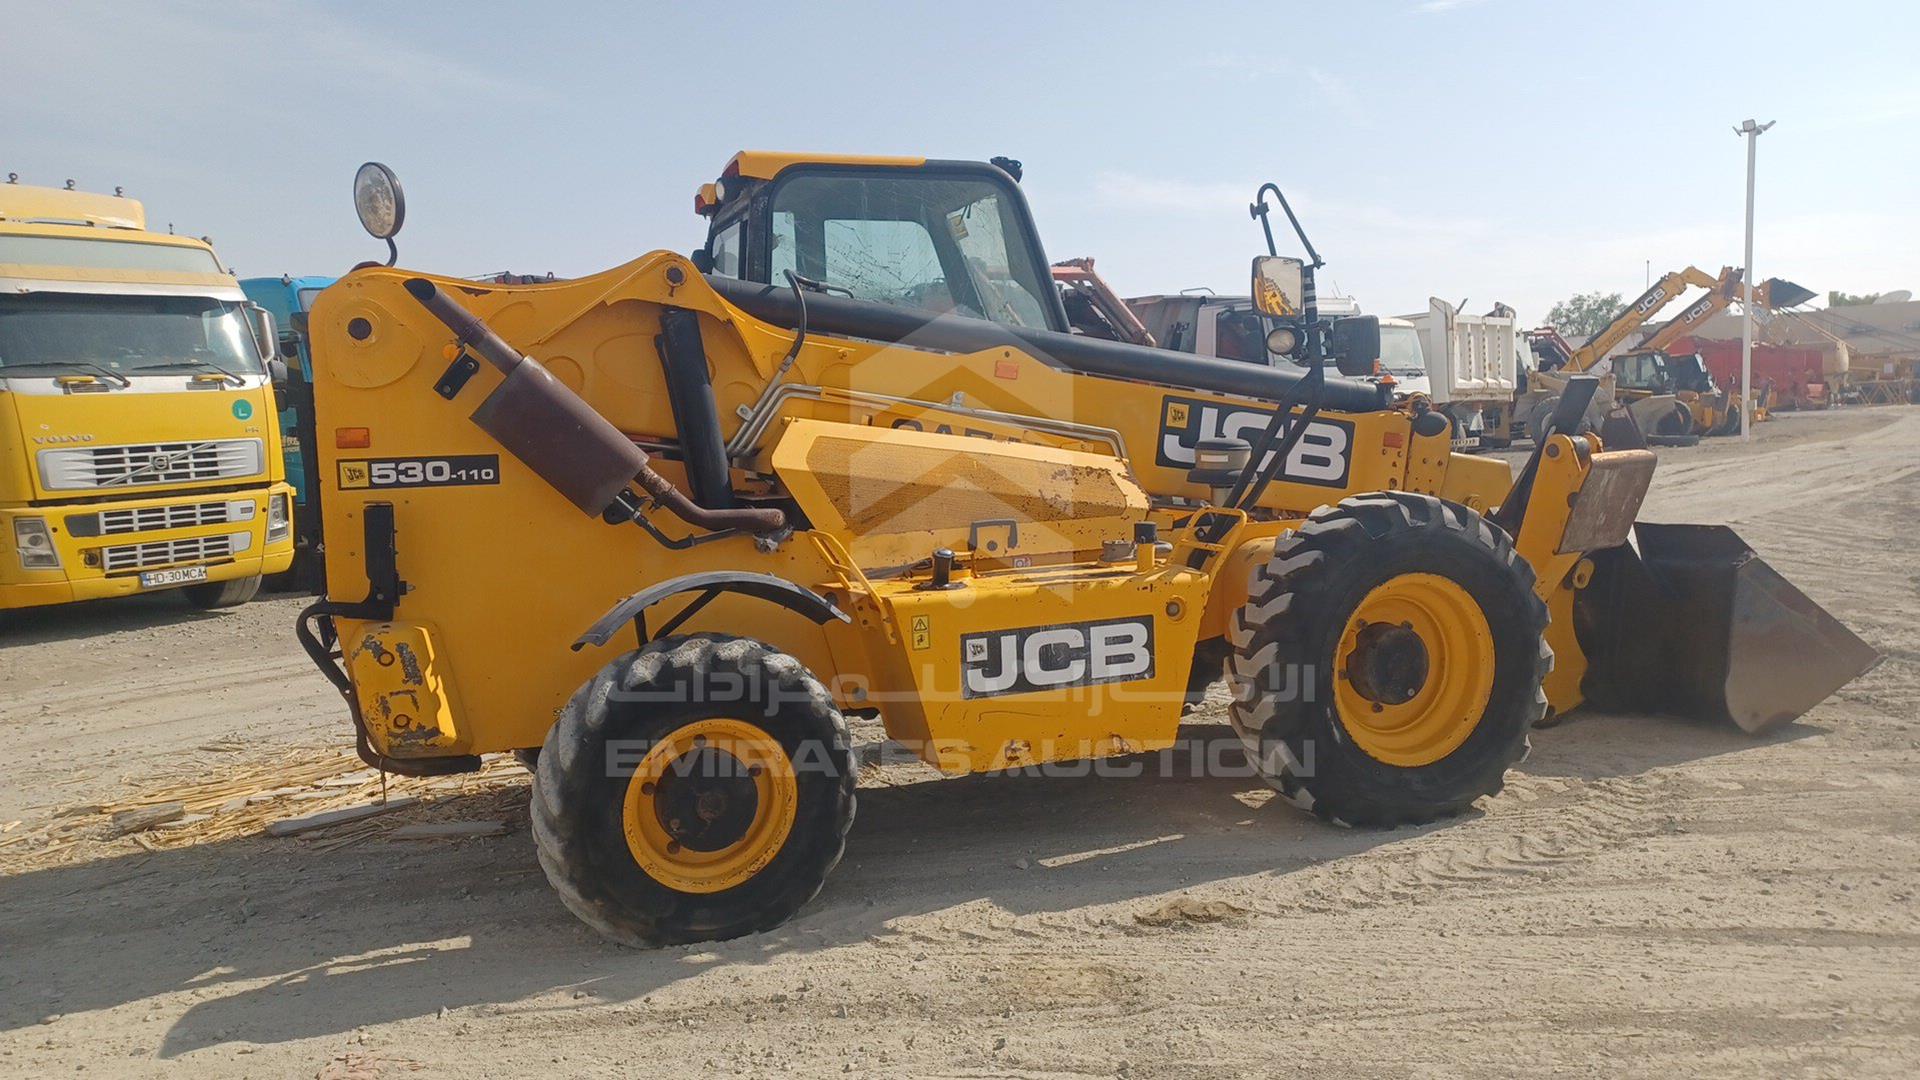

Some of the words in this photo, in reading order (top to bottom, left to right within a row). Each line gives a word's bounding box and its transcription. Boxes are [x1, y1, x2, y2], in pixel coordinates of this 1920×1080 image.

[1638, 288, 1666, 314] JCB
[1685, 301, 1713, 323] JCB
[32, 434, 94, 444] VOLVO
[371, 461, 494, 484] 530-110
[967, 622, 1150, 692] JCB
